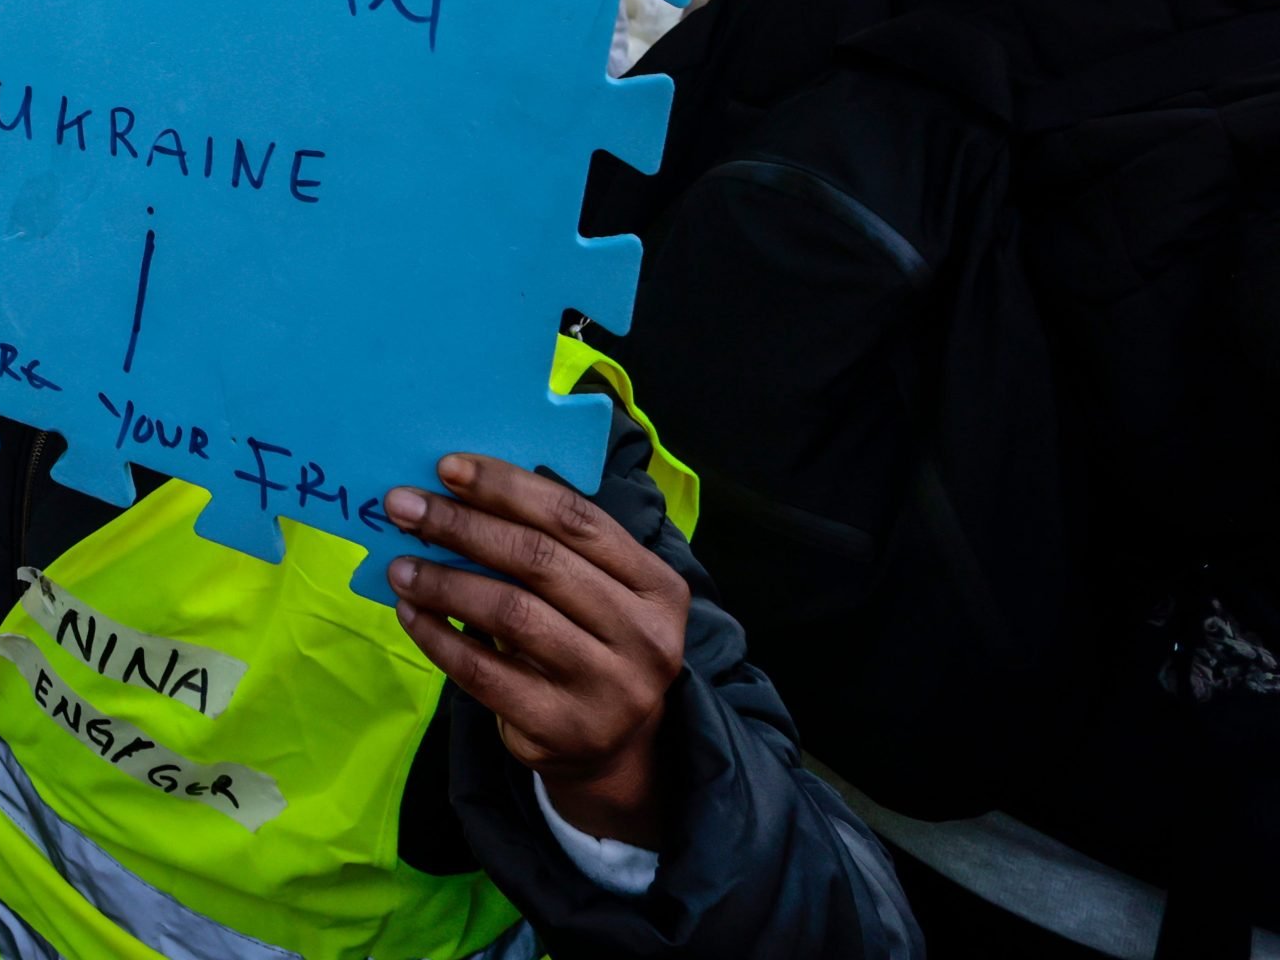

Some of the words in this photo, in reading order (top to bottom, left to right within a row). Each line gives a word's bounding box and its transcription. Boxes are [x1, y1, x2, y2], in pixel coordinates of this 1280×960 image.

[98, 392, 209, 460] YOUR
[234, 436, 405, 540] FRIE
[56, 608, 210, 714] NINA
